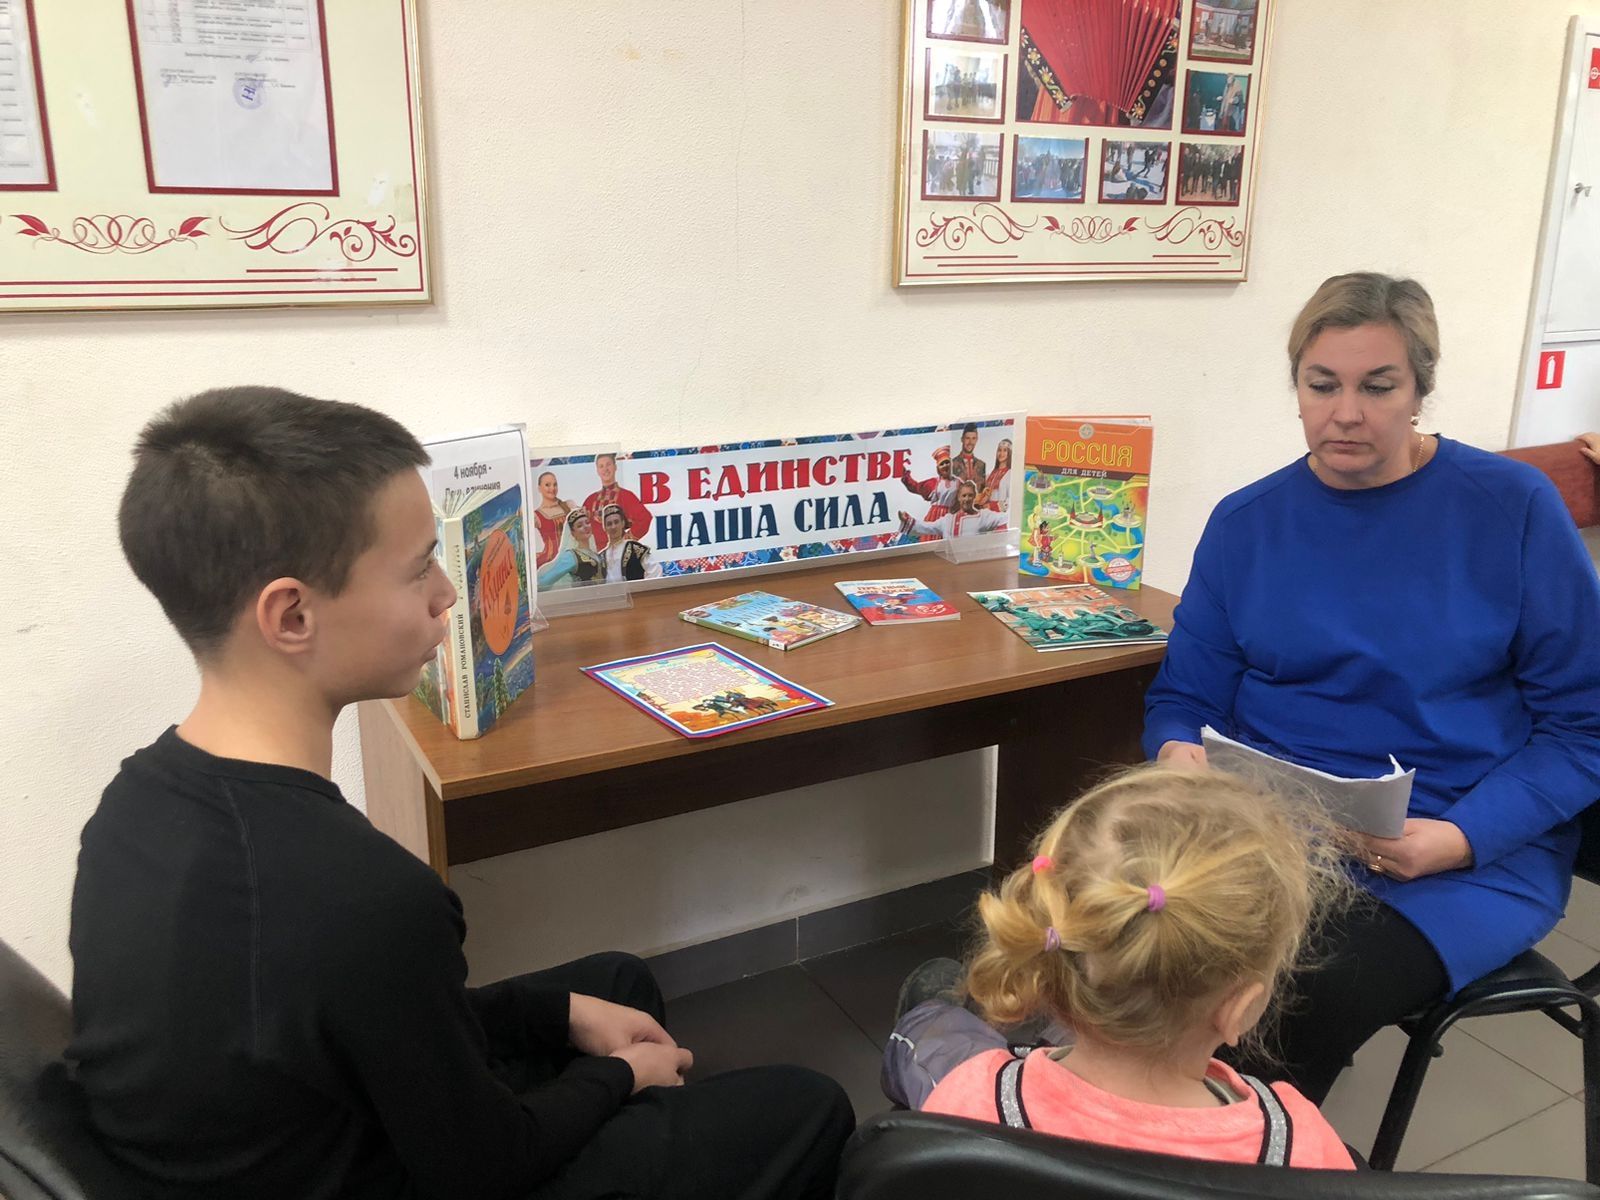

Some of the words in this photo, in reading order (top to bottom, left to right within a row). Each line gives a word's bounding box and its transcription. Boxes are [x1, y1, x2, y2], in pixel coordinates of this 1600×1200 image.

[454, 465, 459, 480] 4
[460, 462, 488, 479] ноября
[1041, 439, 1133, 468] РОССИЯ
[1061, 467, 1078, 476] ДЛЯ
[1080, 469, 1108, 478] ДЕТЕЙ
[638, 471, 672, 505] В
[687, 449, 912, 501] ЕДИНСТВЕ
[655, 504, 780, 551] НАША
[793, 491, 892, 534] СИЛА
[456, 614, 467, 670] РОМАНОВСКИЙ
[462, 674, 471, 719] СТАНИСЛАВ
